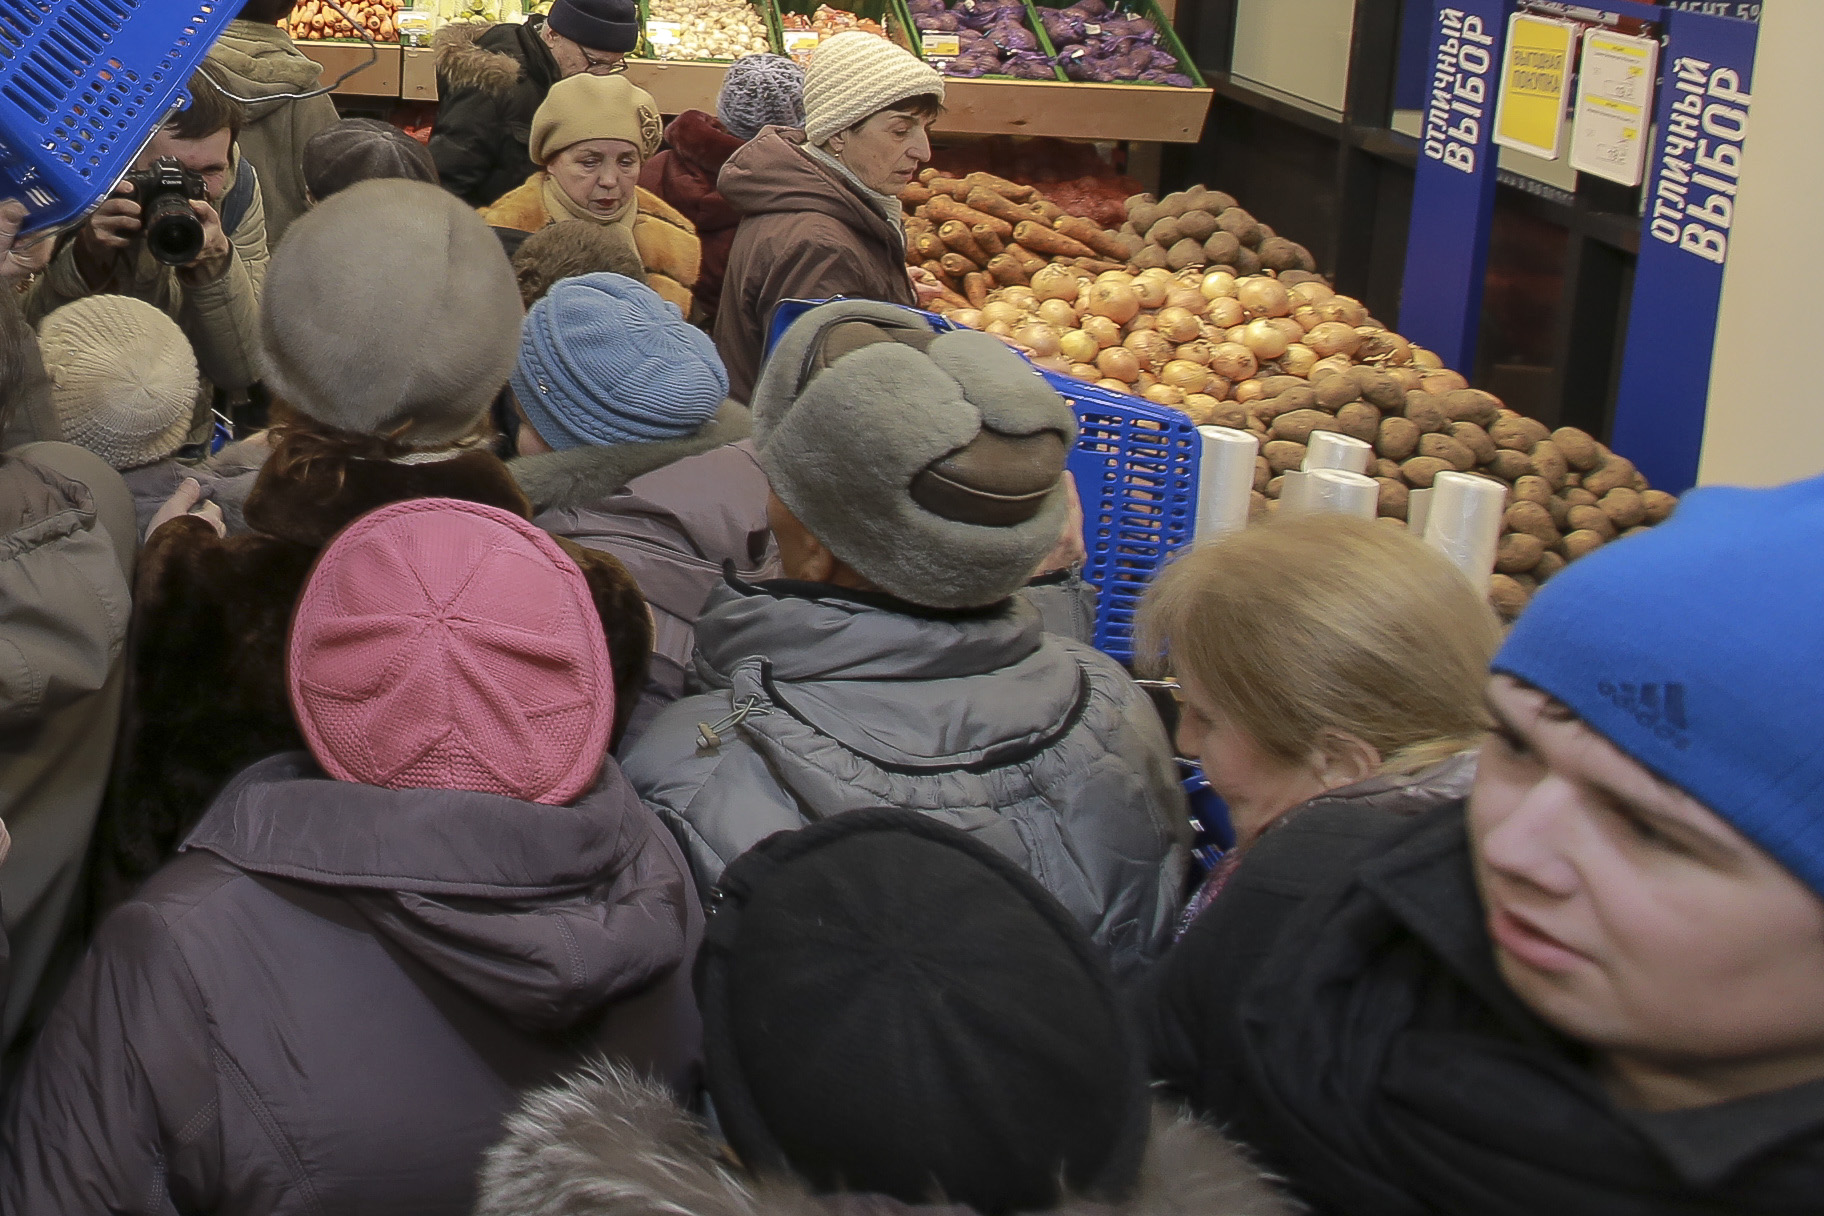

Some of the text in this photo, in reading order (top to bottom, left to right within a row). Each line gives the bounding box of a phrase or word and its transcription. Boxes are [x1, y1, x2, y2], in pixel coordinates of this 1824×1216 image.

[1424, 7, 1465, 160] ОТЛИЧНЫЙ
[1443, 15, 1494, 174] ВЫБОР
[1650, 56, 1711, 244] ОТЛИЧНЫЙ
[1679, 67, 1753, 264] ВЫБОР
